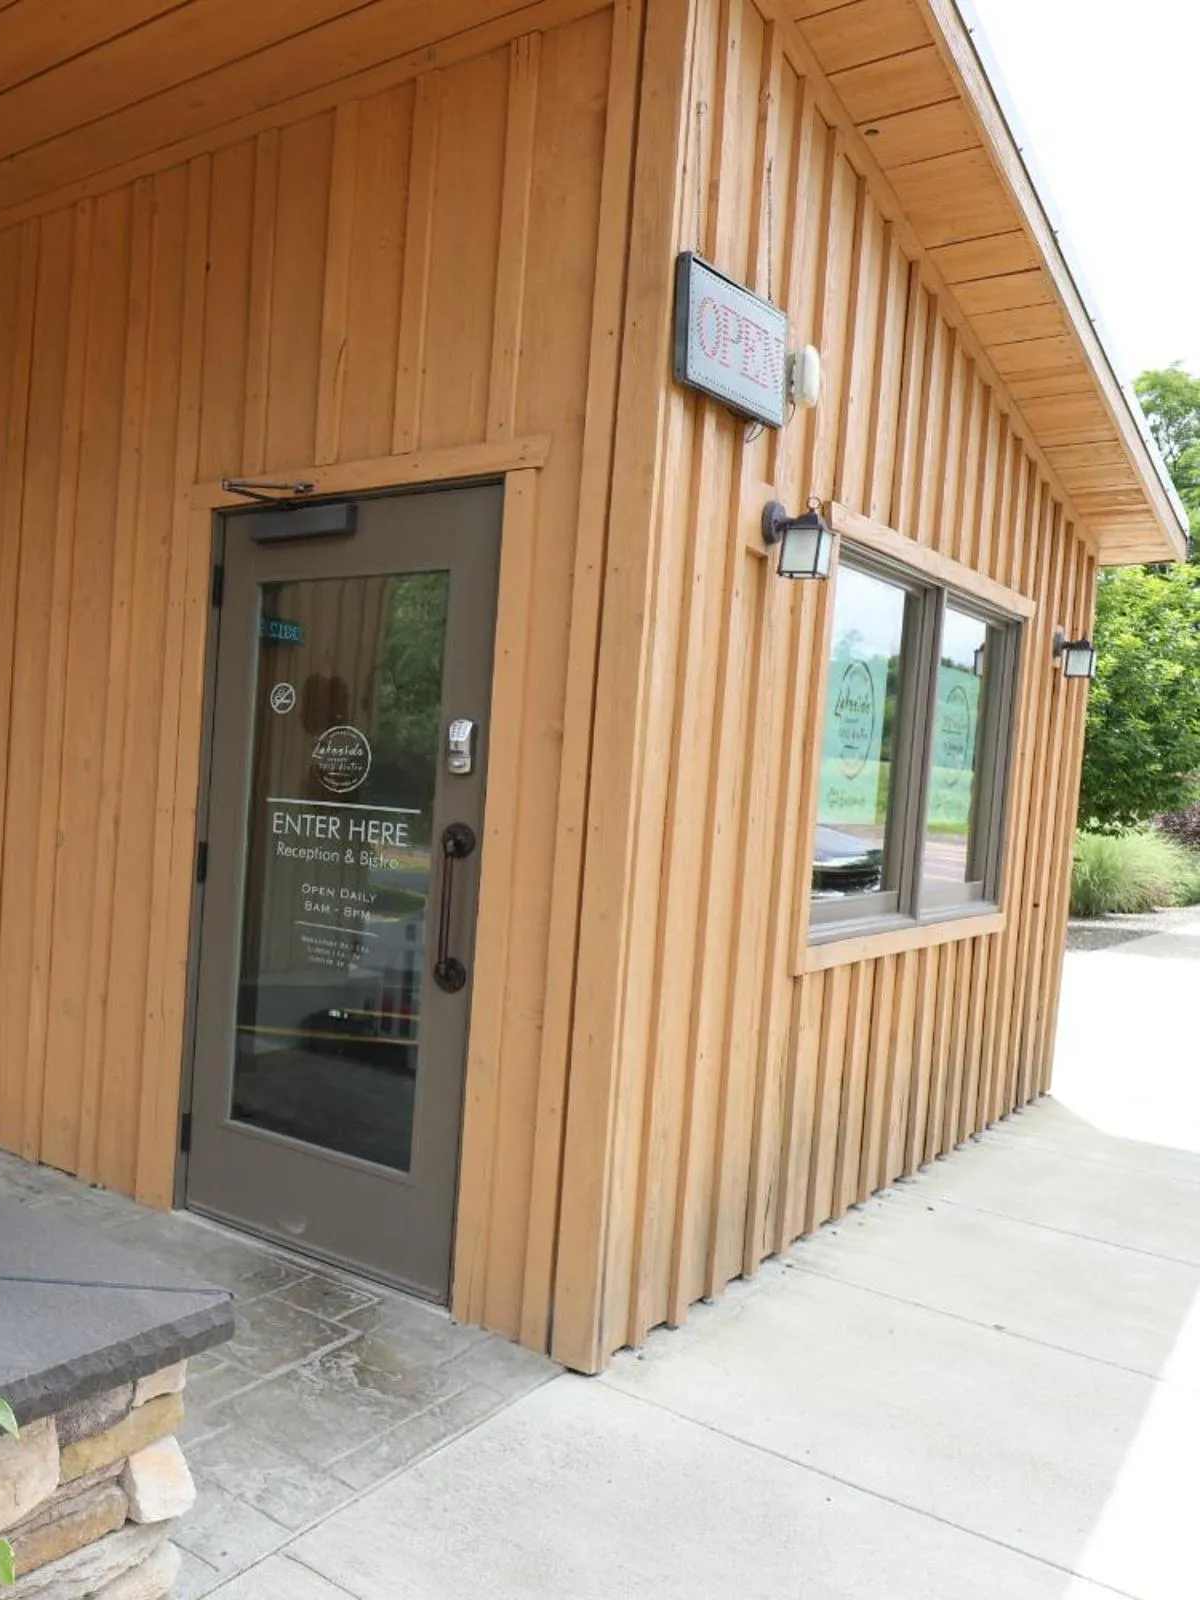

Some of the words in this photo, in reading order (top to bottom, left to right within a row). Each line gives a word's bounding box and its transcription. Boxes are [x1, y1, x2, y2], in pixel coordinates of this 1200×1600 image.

[696, 296, 784, 395] OPEN
[272, 811, 341, 841] ENTER
[348, 818, 409, 848] HERE
[276, 840, 340, 863] Reception
[344, 848, 355, 864] &
[359, 849, 400, 870] Bistro
